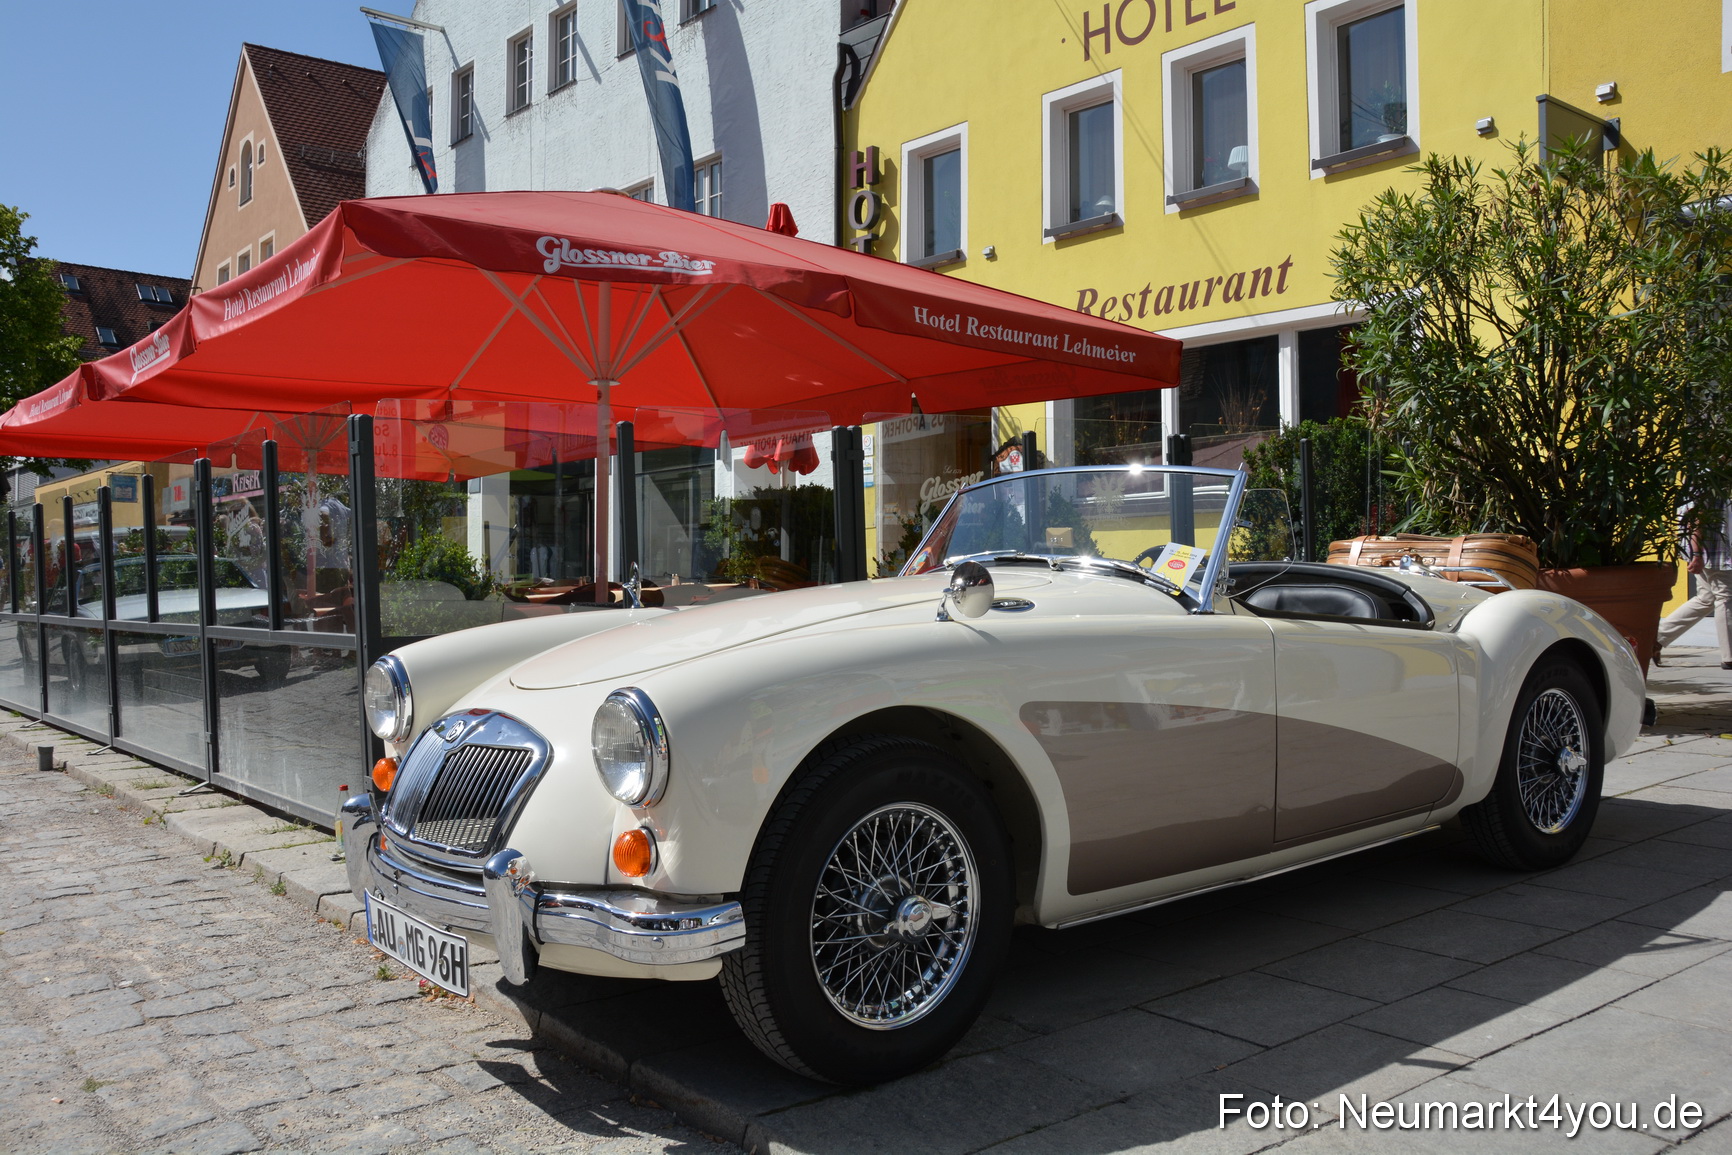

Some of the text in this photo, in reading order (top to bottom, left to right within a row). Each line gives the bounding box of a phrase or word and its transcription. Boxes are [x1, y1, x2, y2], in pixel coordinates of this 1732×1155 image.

[535, 235, 717, 275] Glossner-Bier
[224, 291, 246, 321] Hotel
[243, 271, 288, 311] Restaurant
[1076, 253, 1294, 323] Restaurant
[912, 305, 1137, 363] Hotel Restaurant Lehmeier
[920, 470, 985, 515] Glossner
[405, 921, 426, 970] MG
[428, 935, 466, 989] 96H
